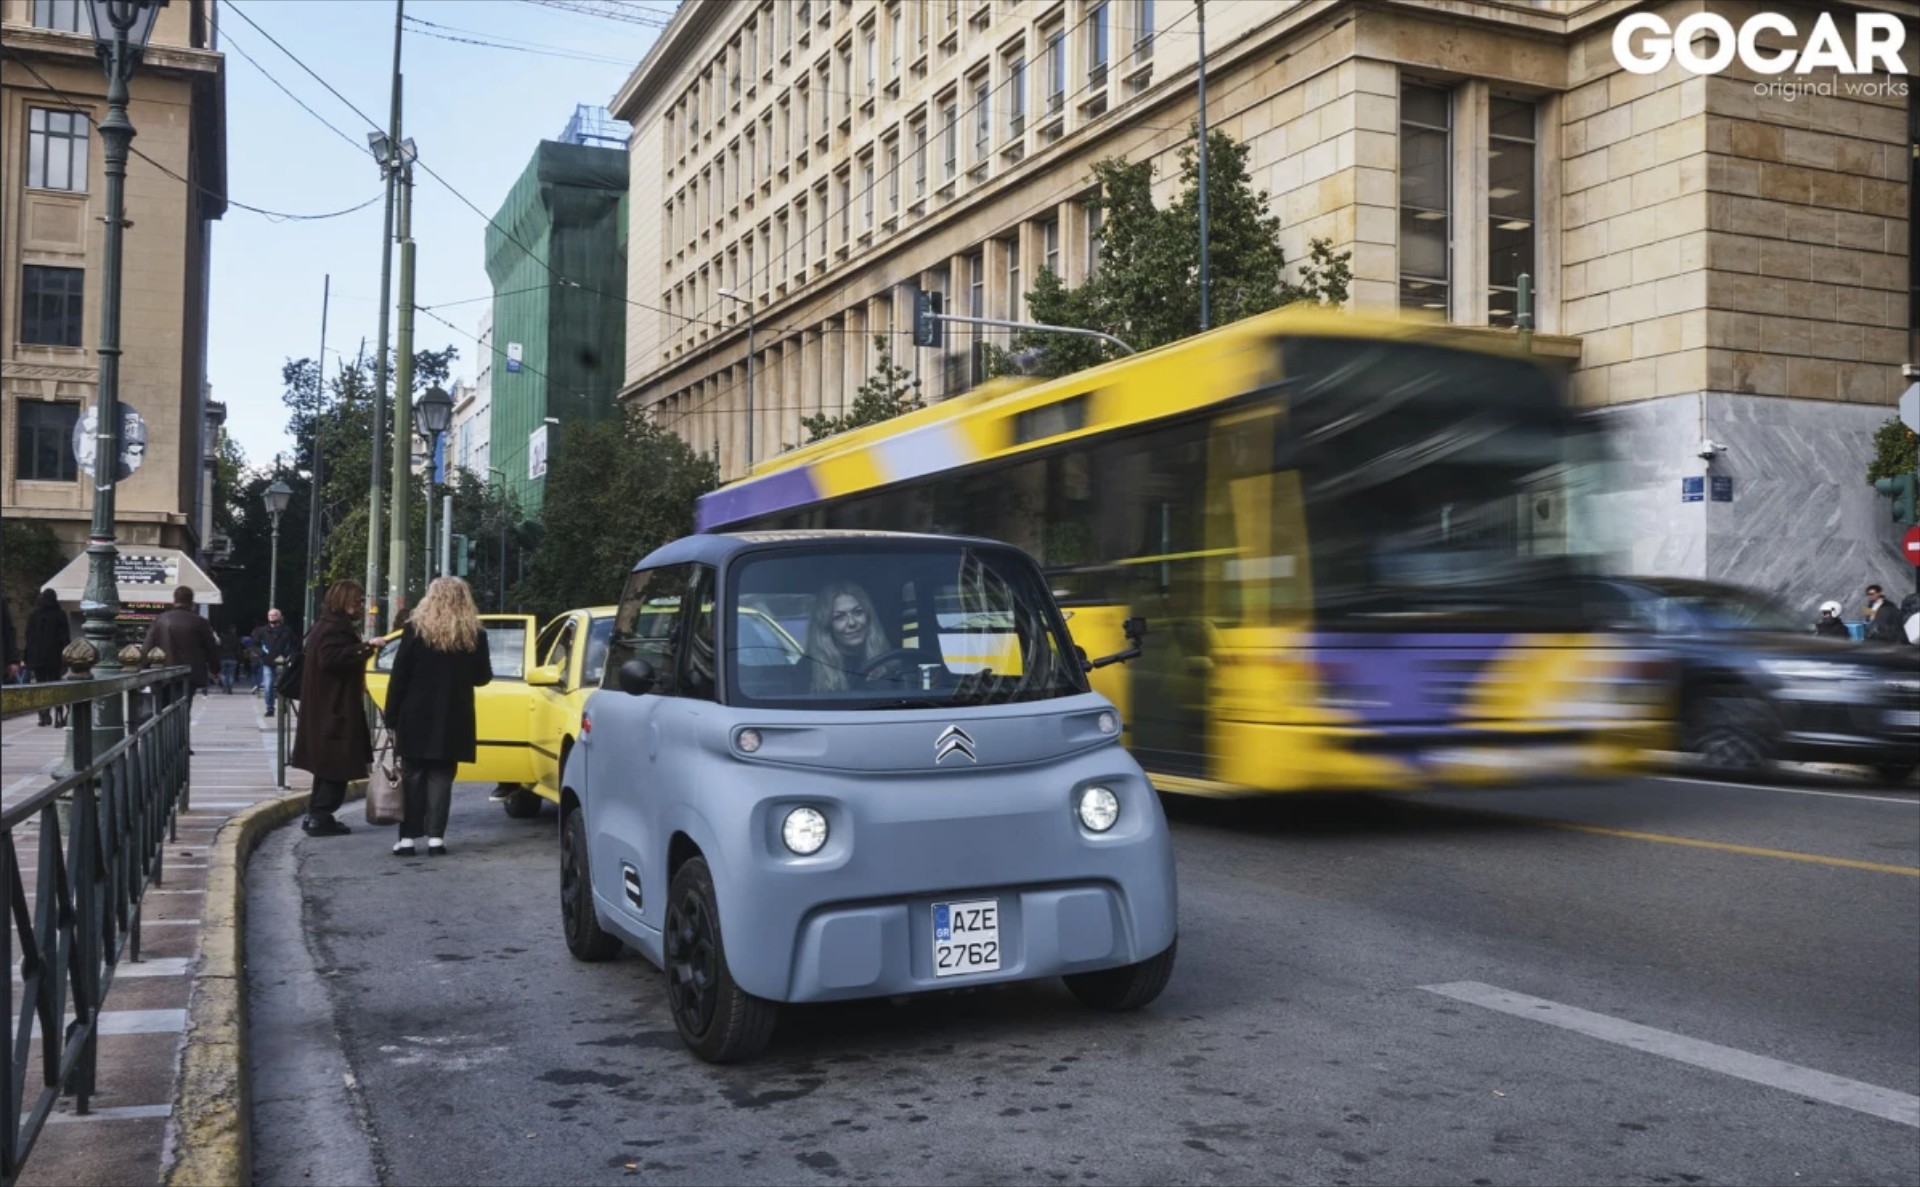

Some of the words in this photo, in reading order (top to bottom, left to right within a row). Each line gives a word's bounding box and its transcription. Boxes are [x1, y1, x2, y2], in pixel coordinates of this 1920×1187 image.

[936, 928, 950, 938] GR
[953, 908, 996, 934] AZE
[938, 941, 998, 968] 2762
